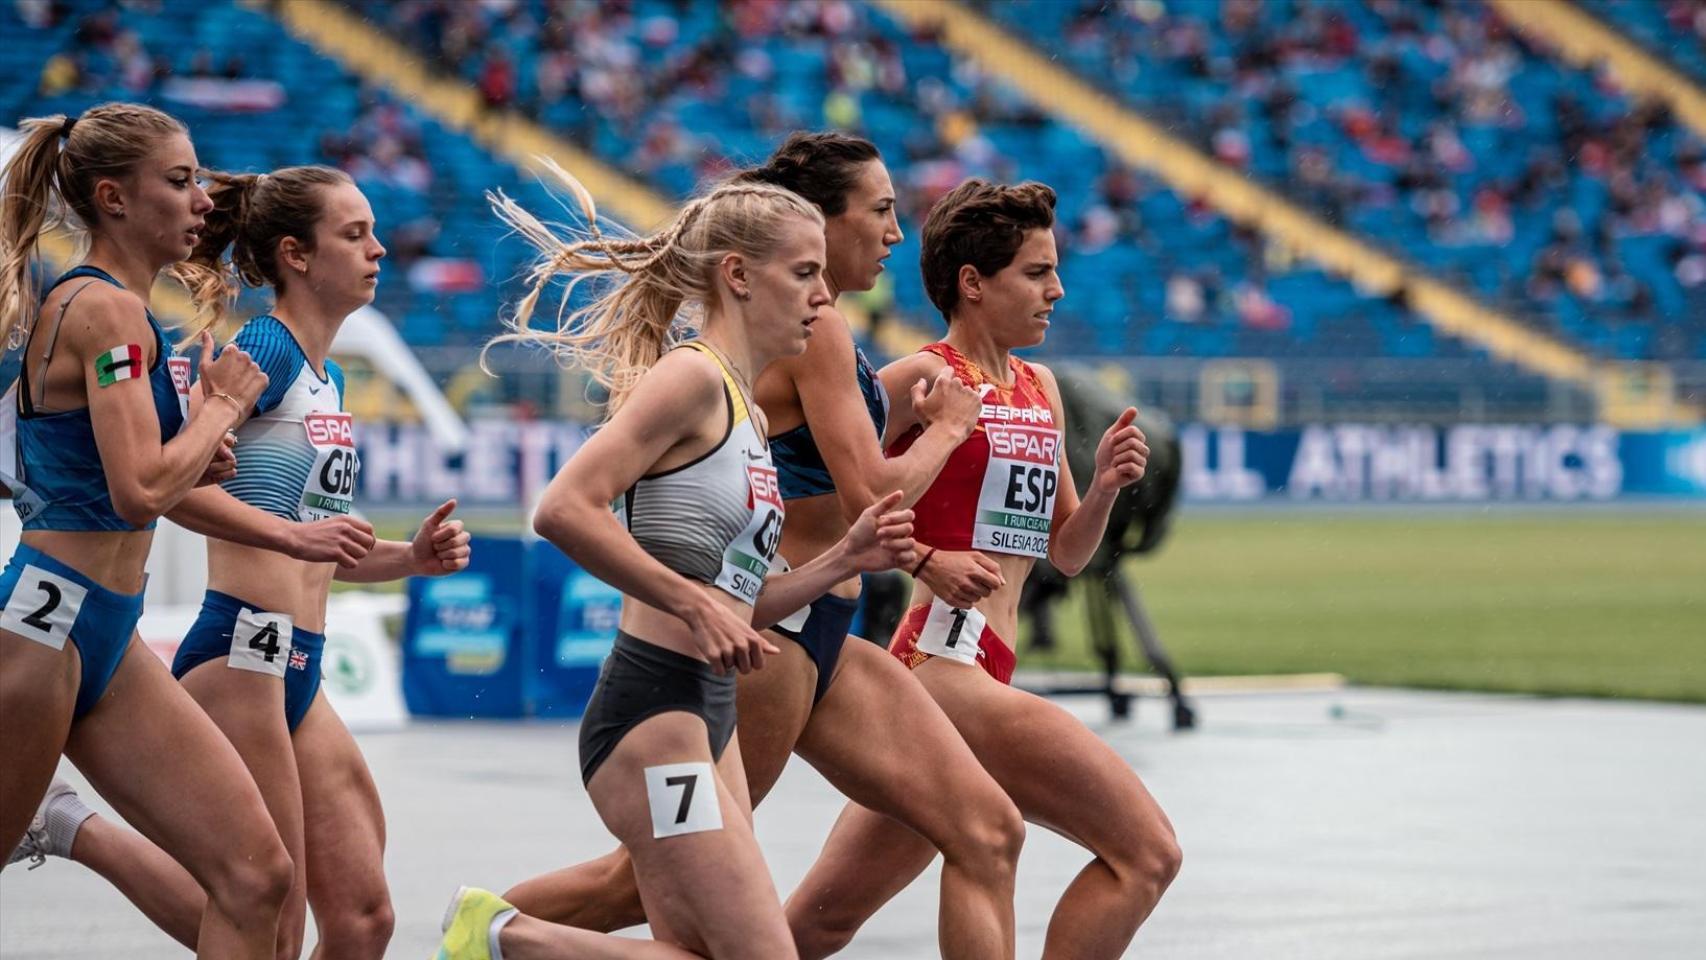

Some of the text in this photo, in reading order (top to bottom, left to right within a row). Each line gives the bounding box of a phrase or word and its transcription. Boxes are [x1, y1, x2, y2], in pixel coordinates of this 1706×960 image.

[991, 431, 1056, 462] SPAR
[1288, 424, 1624, 498] ATHLETICS
[1004, 464, 1057, 514] ESP
[1004, 514, 1009, 525] I
[1010, 515, 1027, 529] RUN
[21, 580, 62, 633] 2
[944, 607, 968, 649] 1
[249, 621, 281, 662] 4
[665, 773, 698, 824] 7
